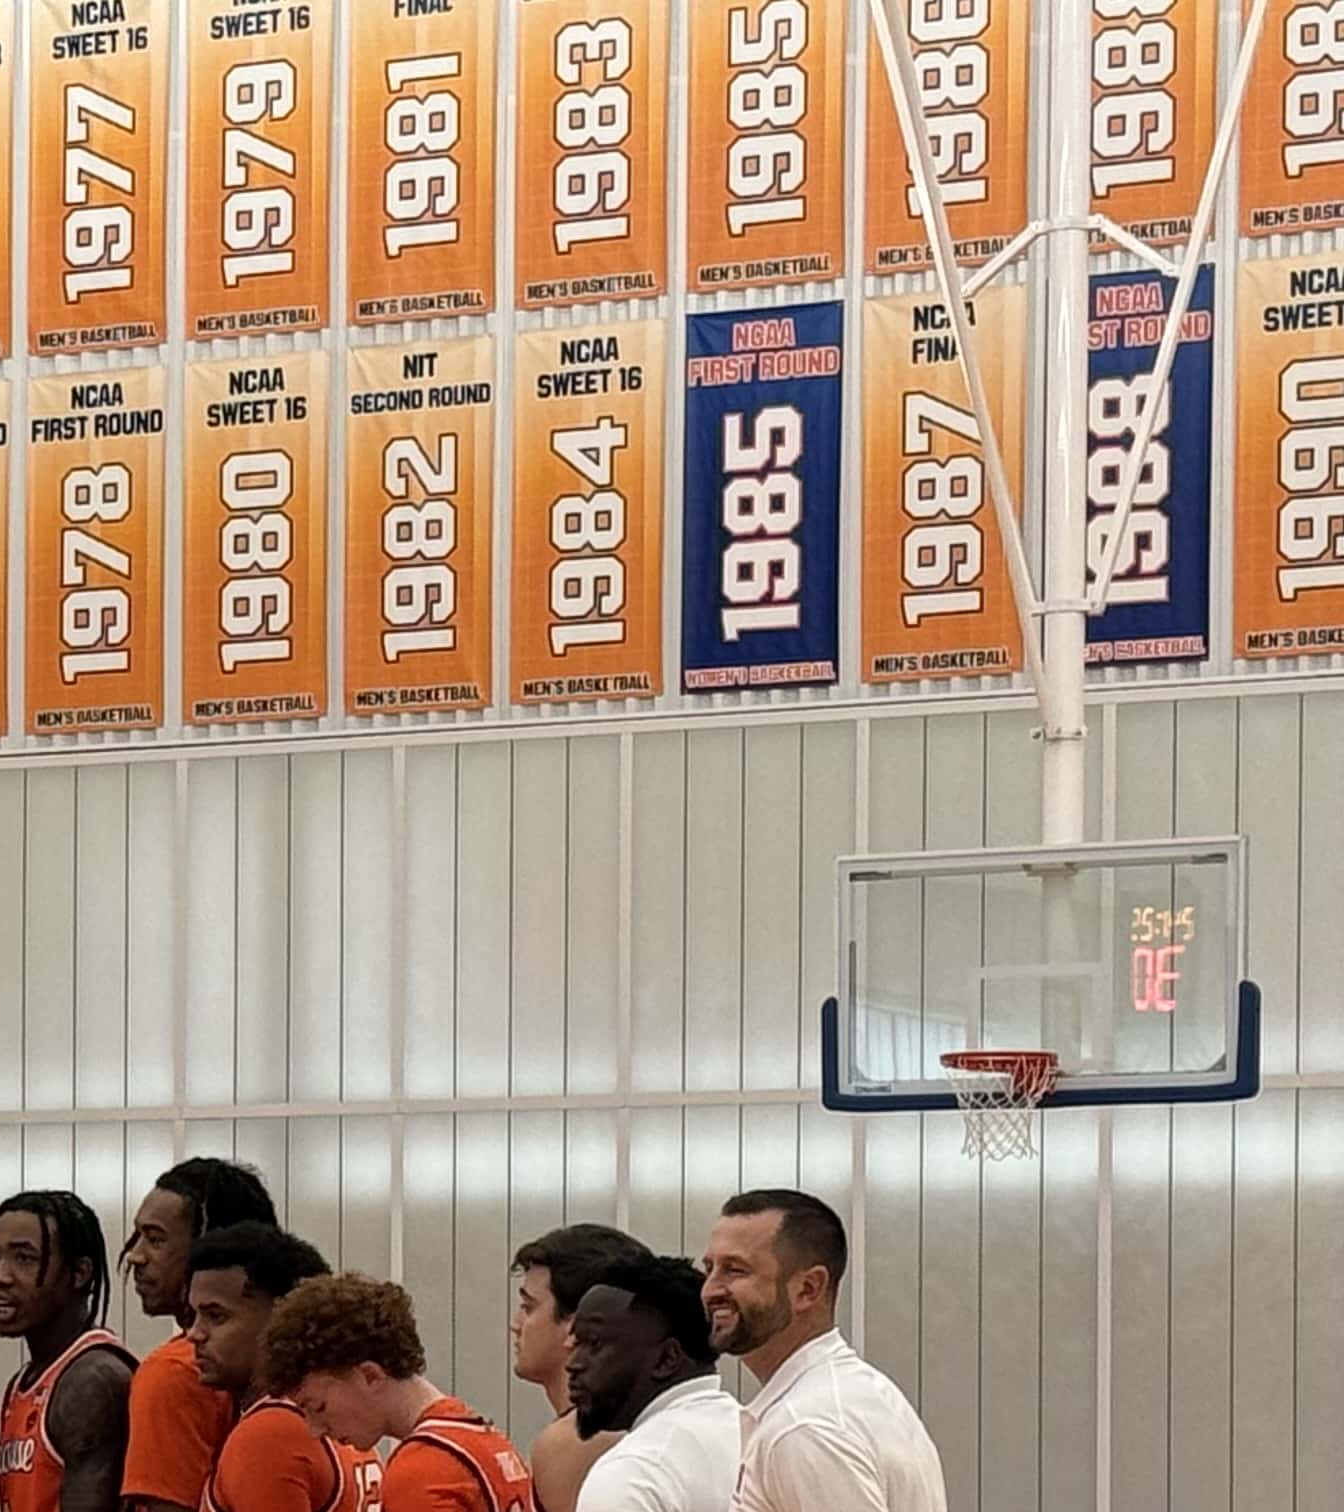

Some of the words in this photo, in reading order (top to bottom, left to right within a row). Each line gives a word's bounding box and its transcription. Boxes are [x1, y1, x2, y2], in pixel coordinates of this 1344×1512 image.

[72, 0, 126, 27] NCAA
[211, 8, 282, 40] SWEET
[288, 6, 311, 31] 16
[52, 29, 120, 60] SWEET
[127, 26, 149, 51] 16
[1090, 0, 1177, 199] 198
[1281, 0, 1344, 180] 198
[552, 16, 633, 255] 1983
[725, 0, 809, 238] 1985
[222, 58, 297, 288] 1979
[383, 52, 462, 259] 1981
[62, 83, 136, 305] 1977
[1290, 266, 1344, 298] NCA
[560, 337, 620, 366] NCAA
[732, 317, 796, 352] NCAA
[228, 367, 286, 396] NCAA
[403, 352, 439, 379] NIT
[536, 368, 613, 399] SWEET
[618, 365, 643, 392] 16
[687, 355, 755, 388] FIRST
[757, 345, 842, 381] ROUND
[70, 383, 124, 410] NCAA
[206, 399, 279, 428] SWEET
[283, 396, 308, 421] 16
[350, 386, 425, 416] SECOND
[428, 382, 492, 408] ROUND
[31, 415, 91, 444] FIRST
[95, 408, 164, 437] ROUND
[721, 403, 804, 644] 1985
[901, 389, 985, 629] 1987
[381, 432, 458, 664] 1982
[548, 415, 628, 658] 1984
[59, 461, 132, 685] 1978
[218, 448, 294, 675] 1980
